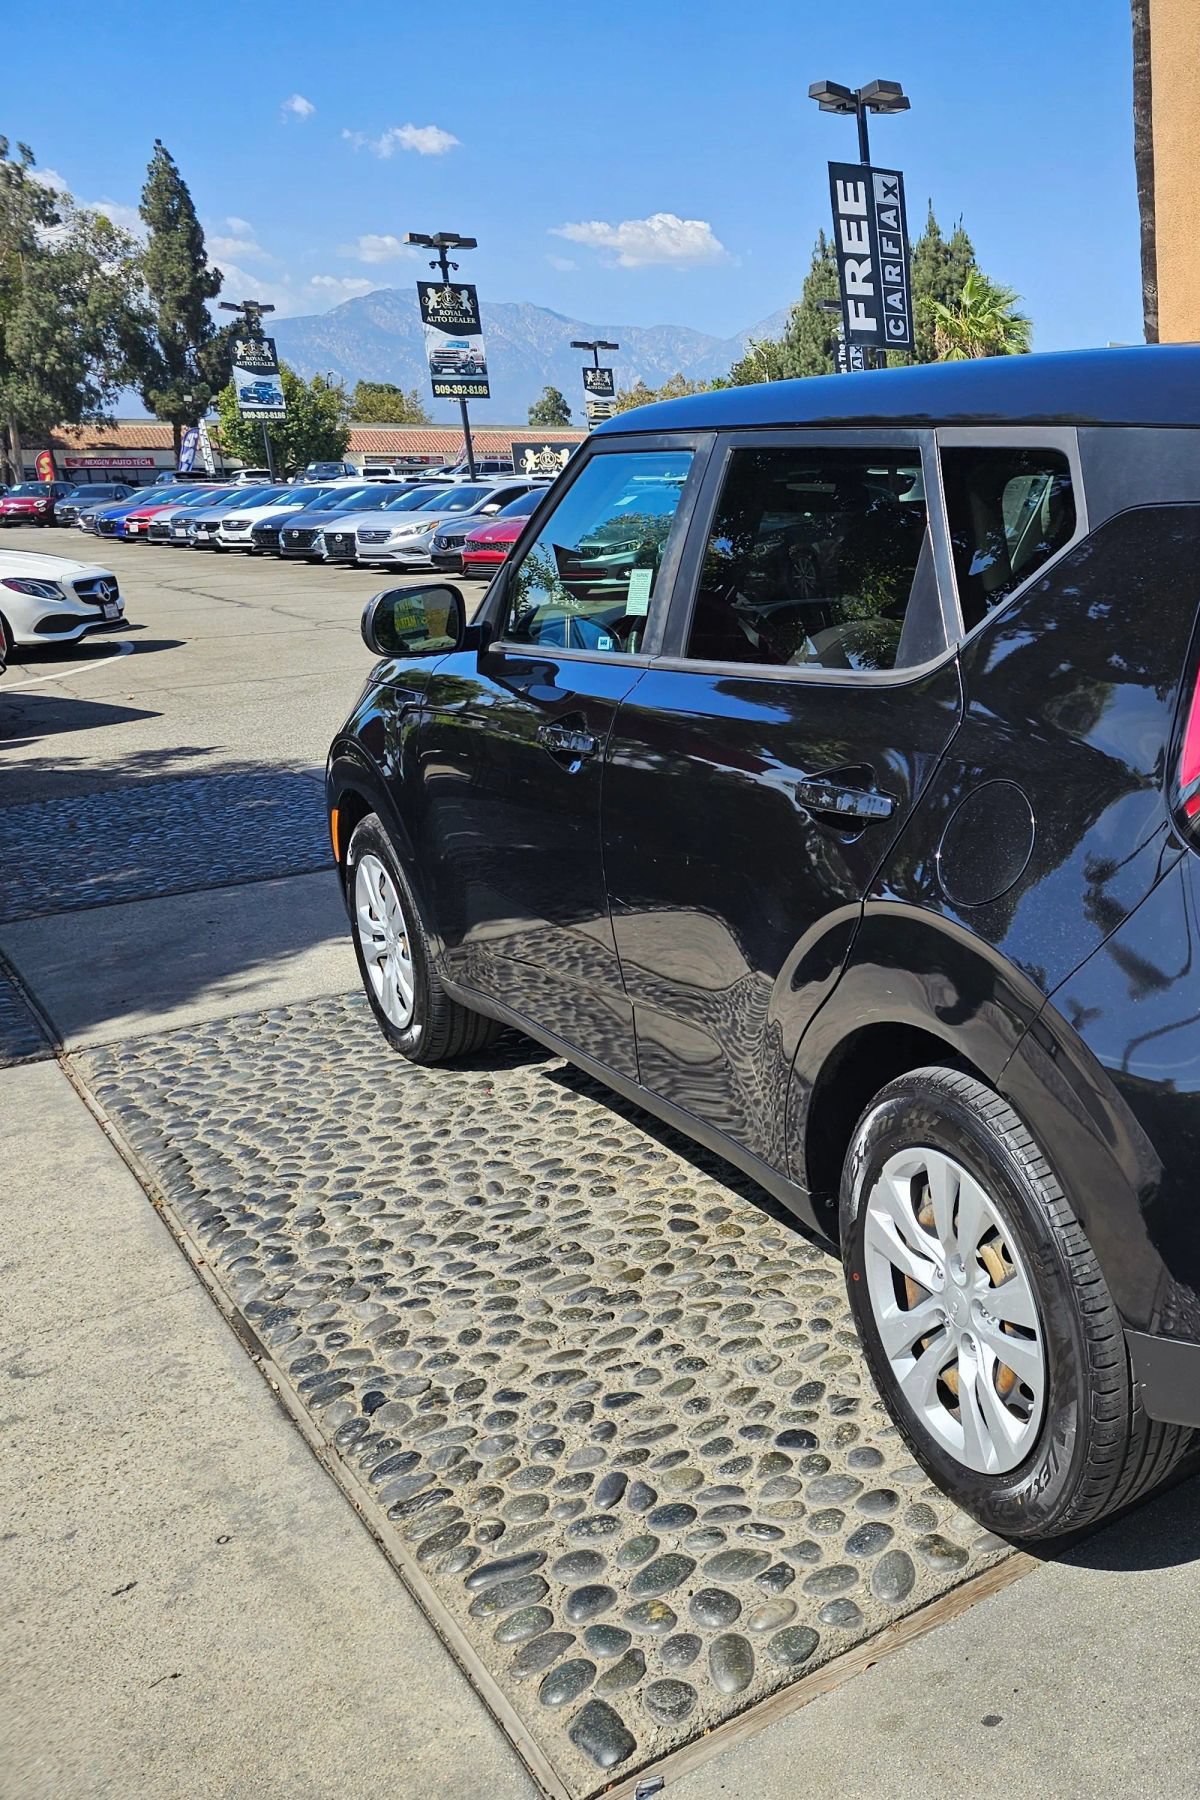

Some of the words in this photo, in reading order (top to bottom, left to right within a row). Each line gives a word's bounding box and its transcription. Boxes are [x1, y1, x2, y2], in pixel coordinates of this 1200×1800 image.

[836, 179, 878, 332] FREE
[880, 179, 905, 337] CARFAX
[439, 309, 462, 317] ROYAL
[426, 315, 448, 323] AUTO
[449, 316, 476, 324] DEALER
[434, 384, 488, 395] 909-392-8186
